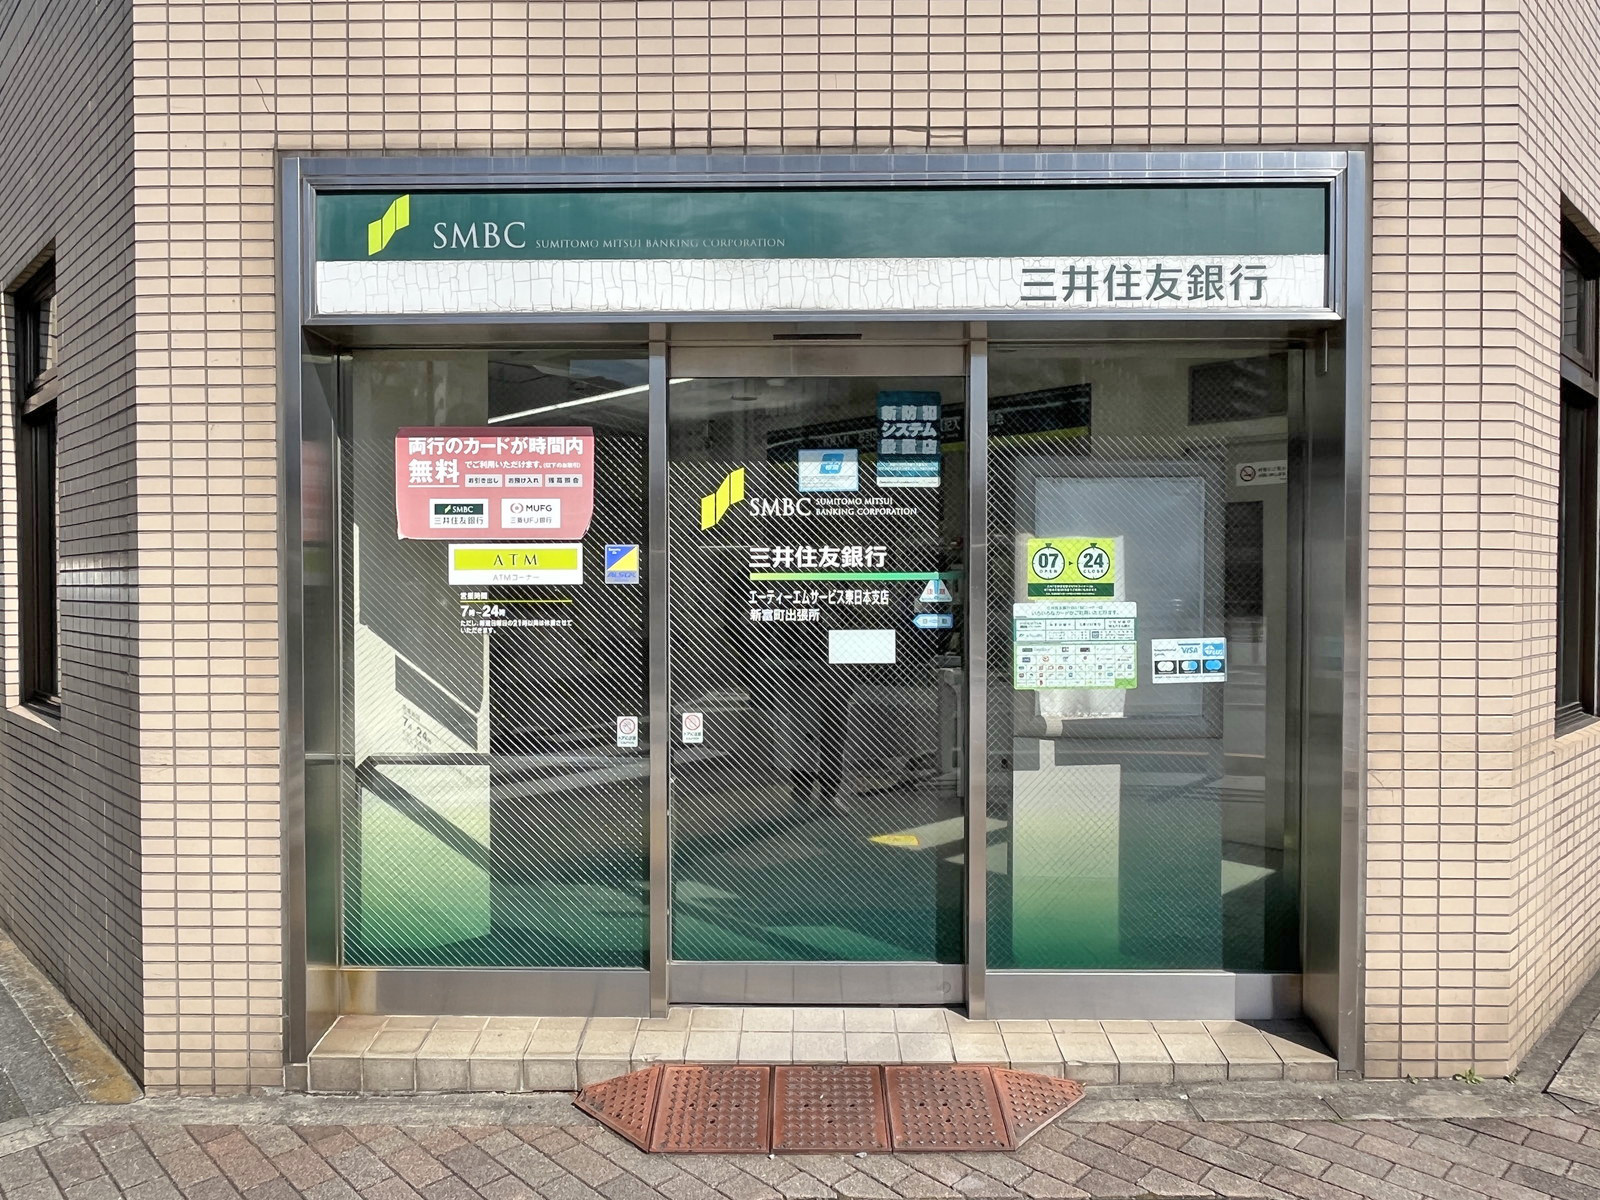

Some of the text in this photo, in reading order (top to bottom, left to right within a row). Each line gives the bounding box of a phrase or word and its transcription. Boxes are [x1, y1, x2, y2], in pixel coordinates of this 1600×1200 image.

[433, 221, 786, 249] SMBC SUMITOMO MITSUI BANKING CORPORATION
[1020, 263, 1268, 302] 三井住友銀行
[881, 422, 937, 438] システム
[408, 436, 584, 456] 両行のカードが時間内
[408, 459, 459, 484] 無料
[452, 505, 474, 513] SMBC
[526, 504, 552, 512] MUFG
[749, 498, 812, 517] SMBC
[865, 497, 893, 505] MITSUI
[493, 553, 538, 566] ATM
[749, 546, 887, 568] 三井住友銀行
[1038, 553, 1059, 568] 07
[1083, 553, 1104, 568] 24
[492, 574, 540, 582] ATMコーナー
[749, 589, 889, 605] エーティーエムサービス東日本支店
